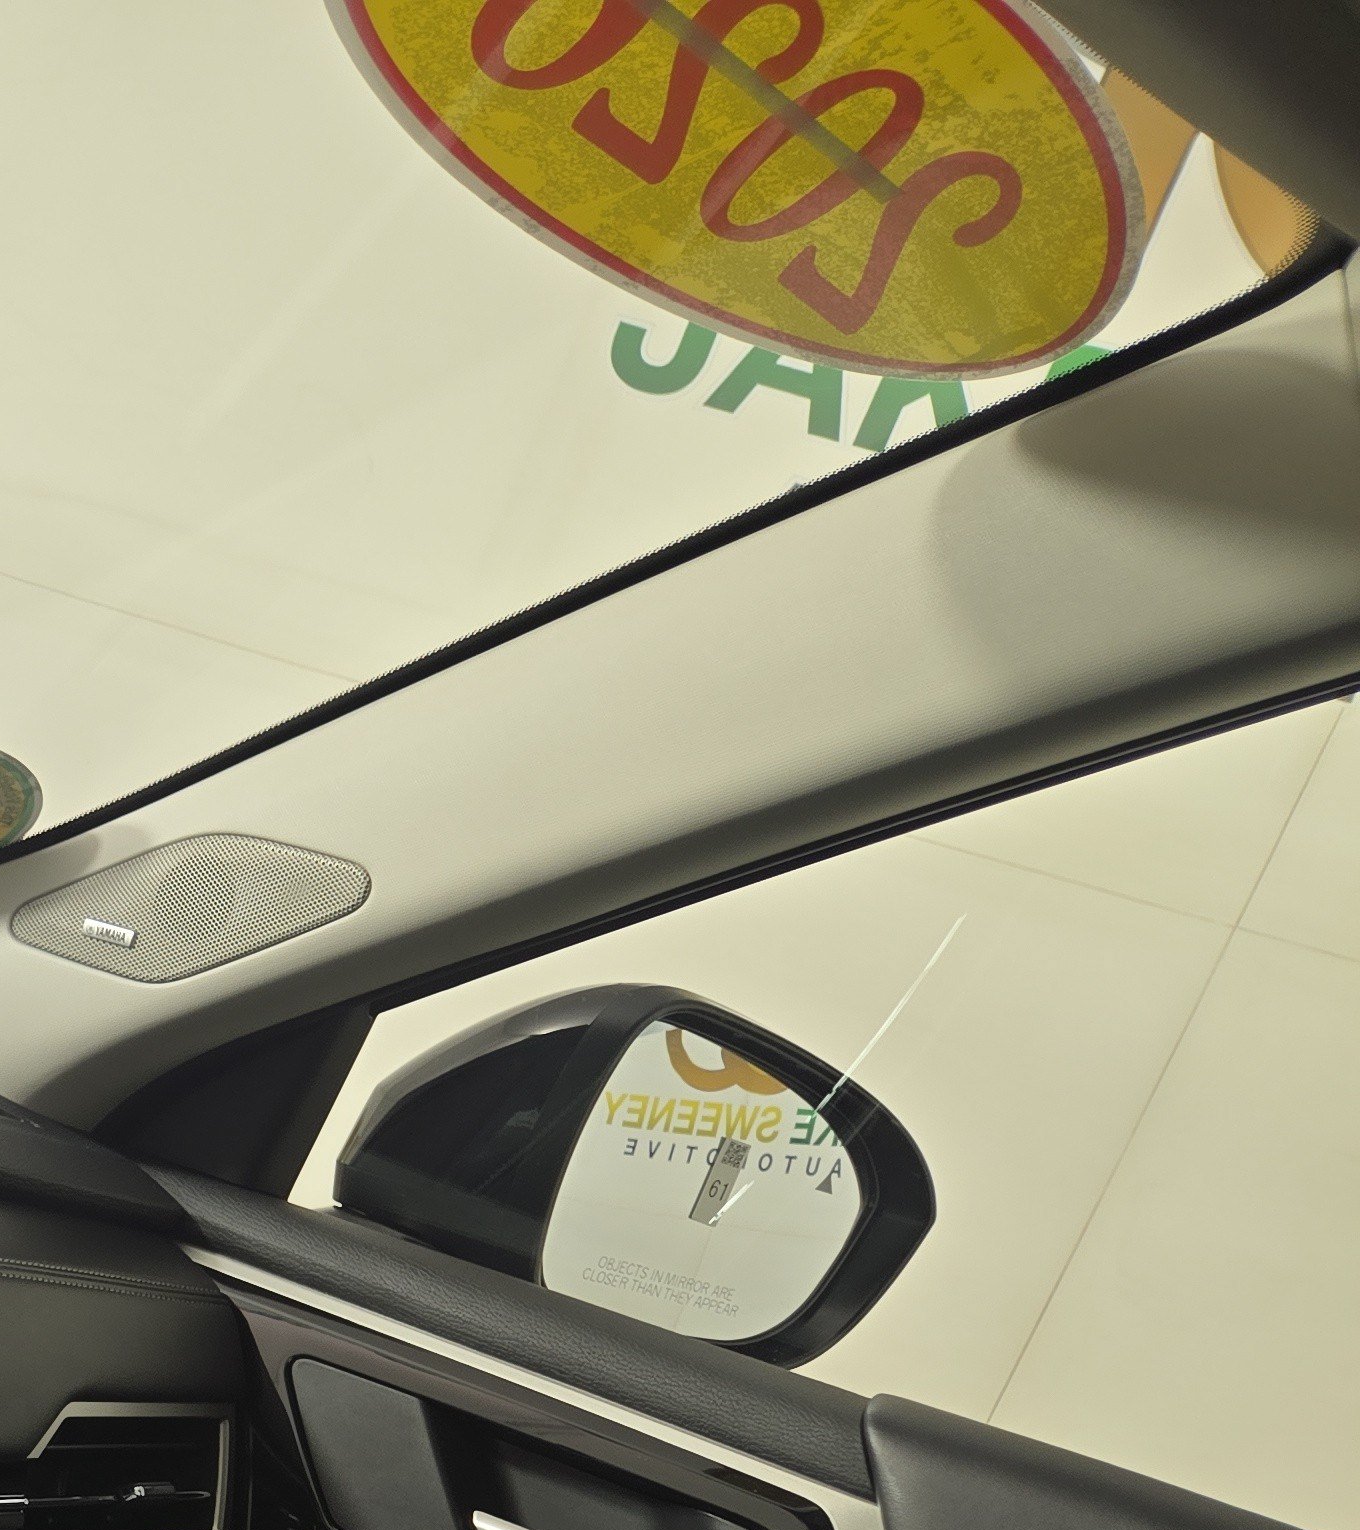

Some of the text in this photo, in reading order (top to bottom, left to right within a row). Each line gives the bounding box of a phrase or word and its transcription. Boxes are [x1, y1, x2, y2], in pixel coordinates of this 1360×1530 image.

[95, 926, 126, 943] YAMAHA
[708, 1179, 730, 1202] 61
[582, 1267, 739, 1317] CLOSER THAN THEY APPEAR
[598, 1256, 736, 1301] OBJECTS IN MIRROR ARE
